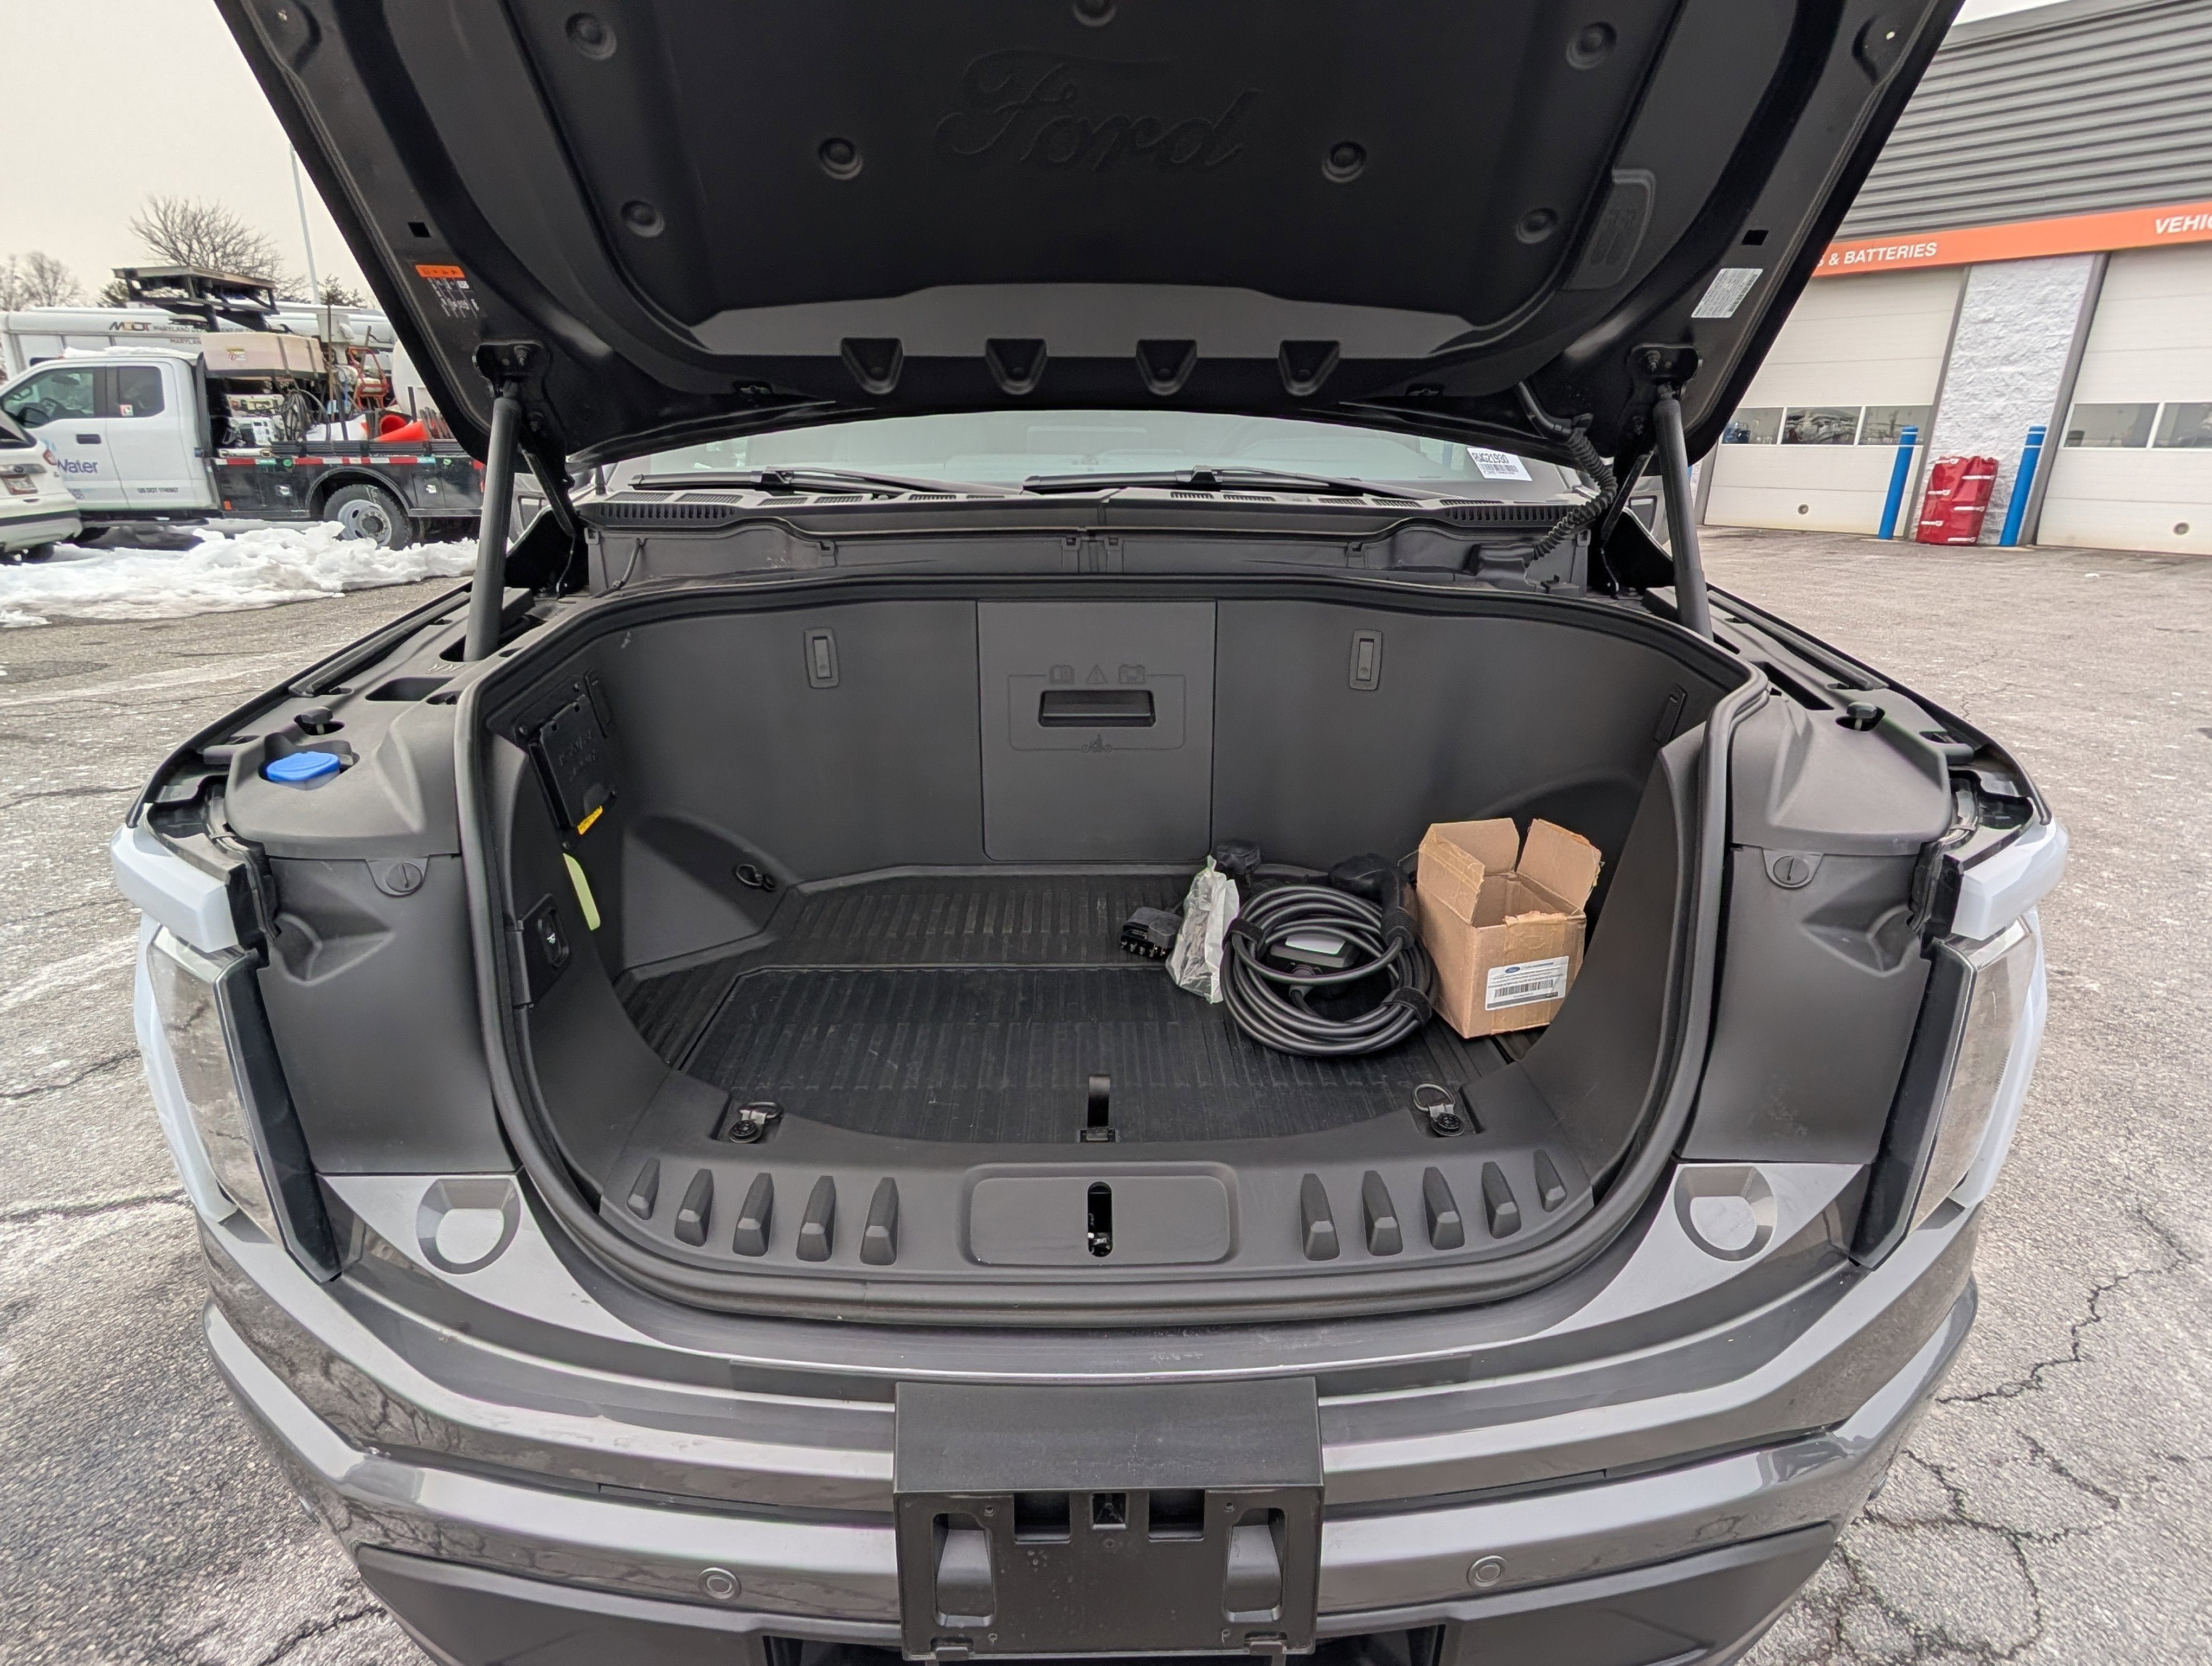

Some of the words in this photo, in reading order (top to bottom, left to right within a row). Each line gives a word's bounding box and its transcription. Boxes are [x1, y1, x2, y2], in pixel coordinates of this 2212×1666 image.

[934, 47, 1266, 172] Ford
[1828, 252, 1840, 266] &
[1843, 241, 1938, 265] BATTERIES
